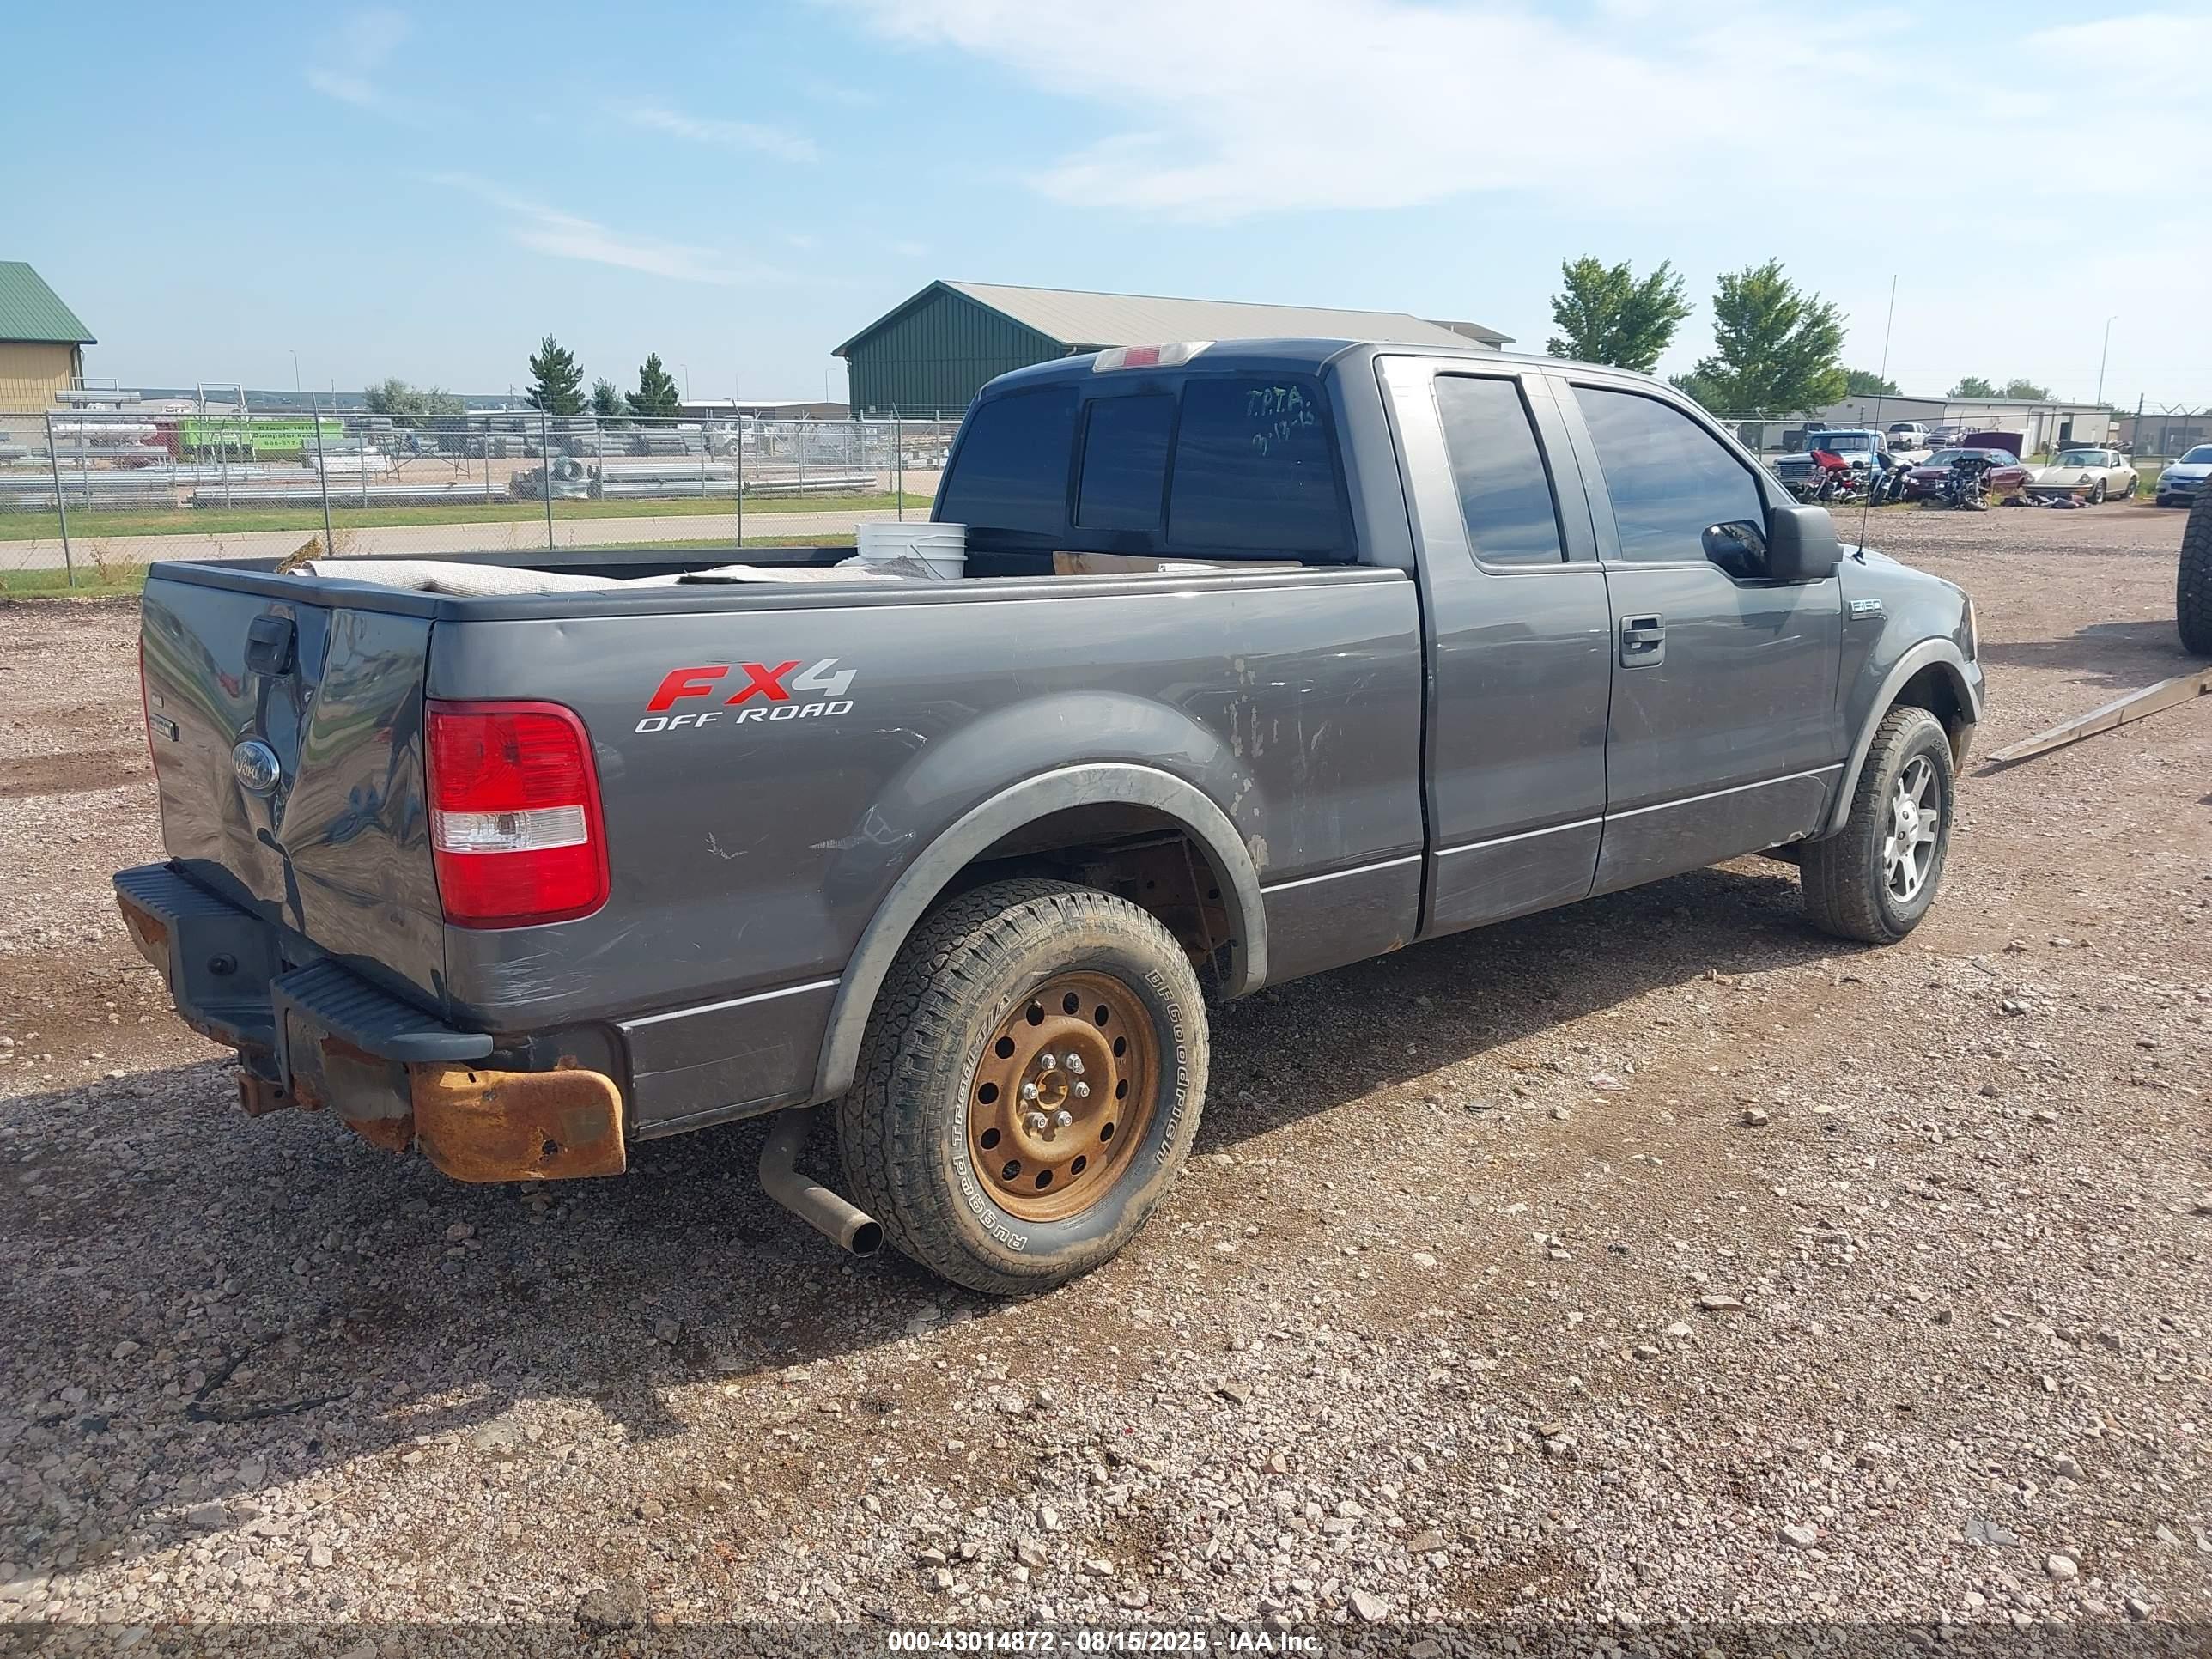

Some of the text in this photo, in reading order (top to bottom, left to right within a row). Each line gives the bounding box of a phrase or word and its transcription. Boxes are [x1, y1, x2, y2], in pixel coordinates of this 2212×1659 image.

[635, 700, 854, 733] OFF ROAD
[646, 658, 857, 713] FX4
[951, 993, 1028, 1251] Rugged Trail T/A
[1145, 969, 1190, 1165] BFGoodrich
